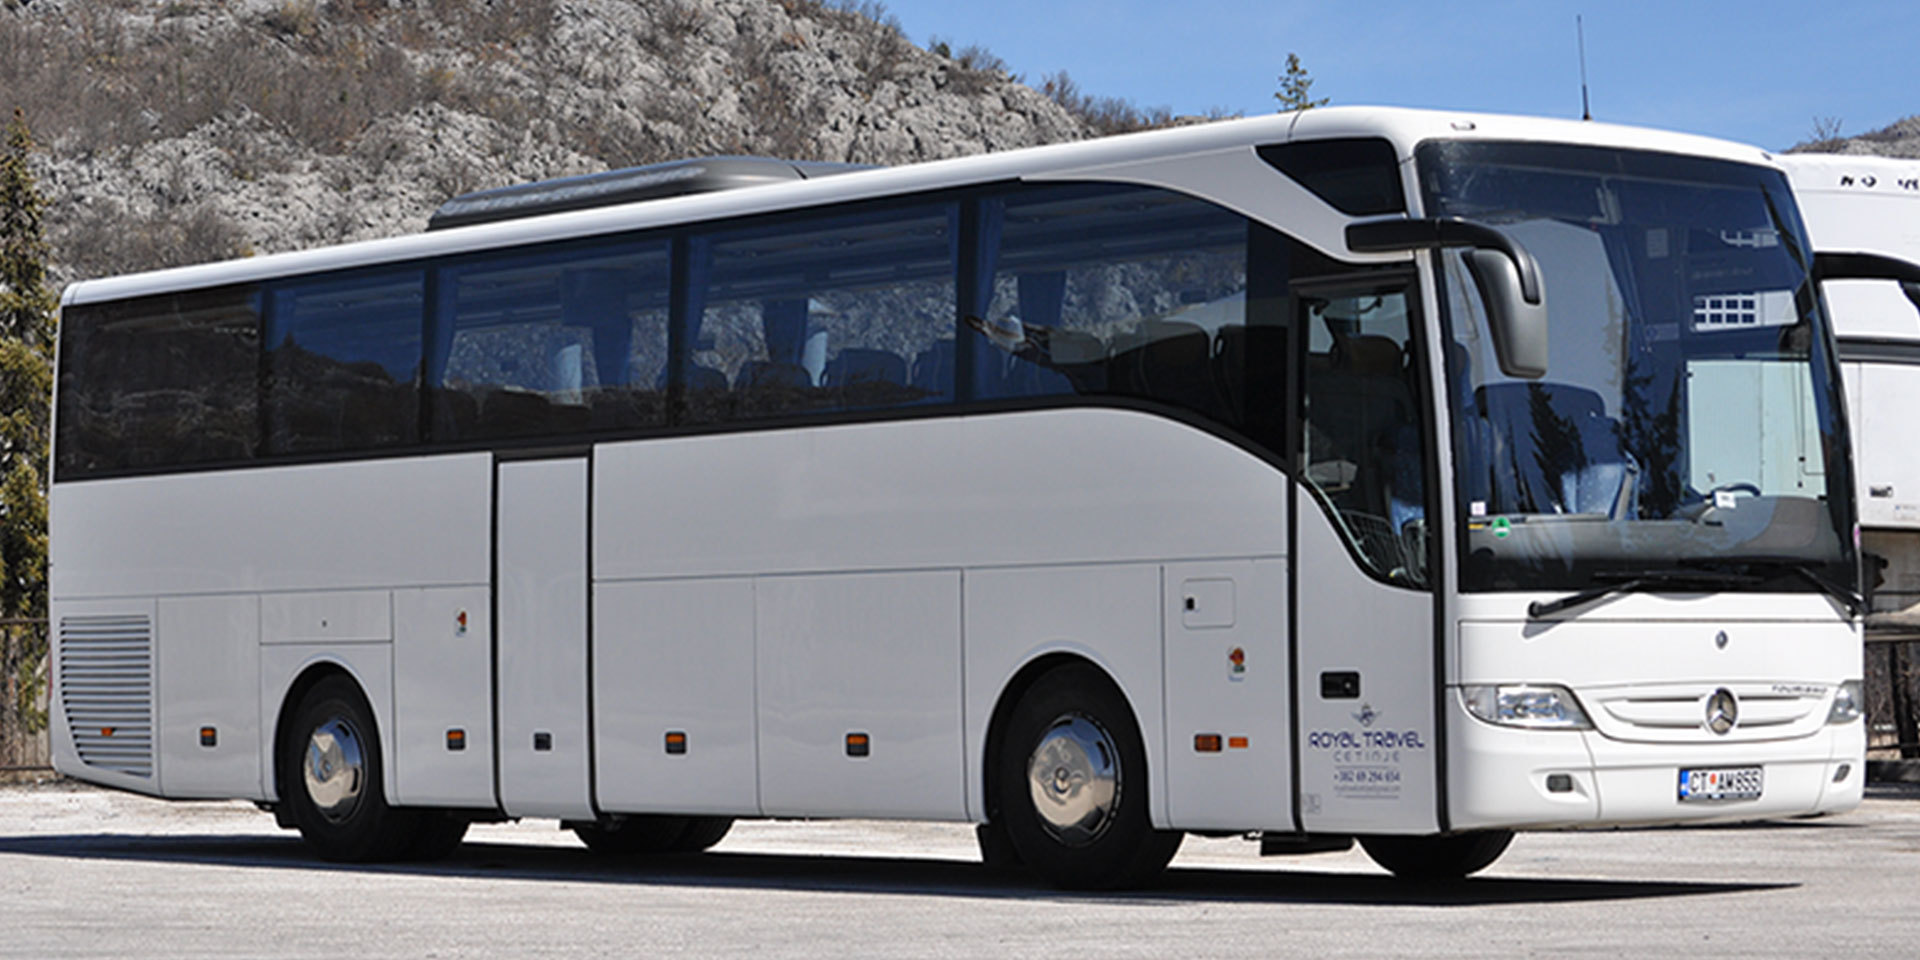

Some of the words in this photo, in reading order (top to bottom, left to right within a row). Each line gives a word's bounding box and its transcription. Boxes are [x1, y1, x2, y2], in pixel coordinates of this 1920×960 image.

[1308, 731, 1361, 748] ROYAL
[1362, 731, 1425, 748] TRAVEL
[1333, 751, 1400, 763] CETINJE
[1689, 771, 1708, 793] CT
